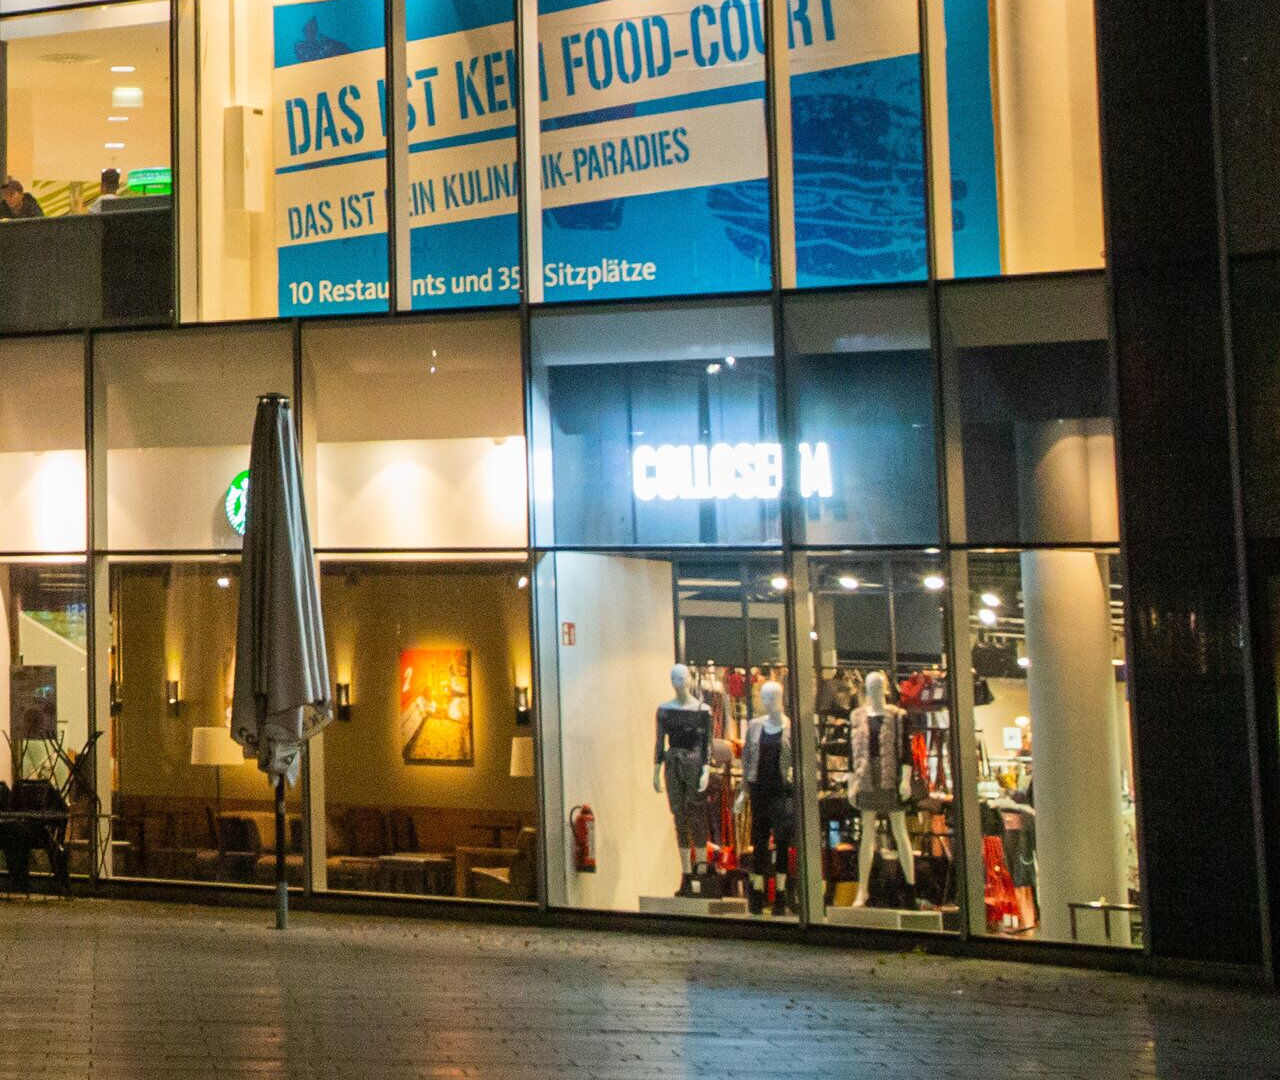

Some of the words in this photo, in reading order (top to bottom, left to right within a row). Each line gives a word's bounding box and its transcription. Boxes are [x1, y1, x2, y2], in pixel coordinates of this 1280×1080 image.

[285, 84, 365, 156] DAS
[287, 199, 334, 241] DAS
[339, 190, 376, 230] IST
[383, 178, 436, 218] IN
[442, 126, 691, 211] KULINAIK-PARADIES
[288, 280, 314, 305] 10
[318, 274, 446, 303] Restaunts
[451, 266, 493, 294] und
[543, 258, 657, 291] Sitzplätze
[631, 441, 834, 502] COLLOSEM
